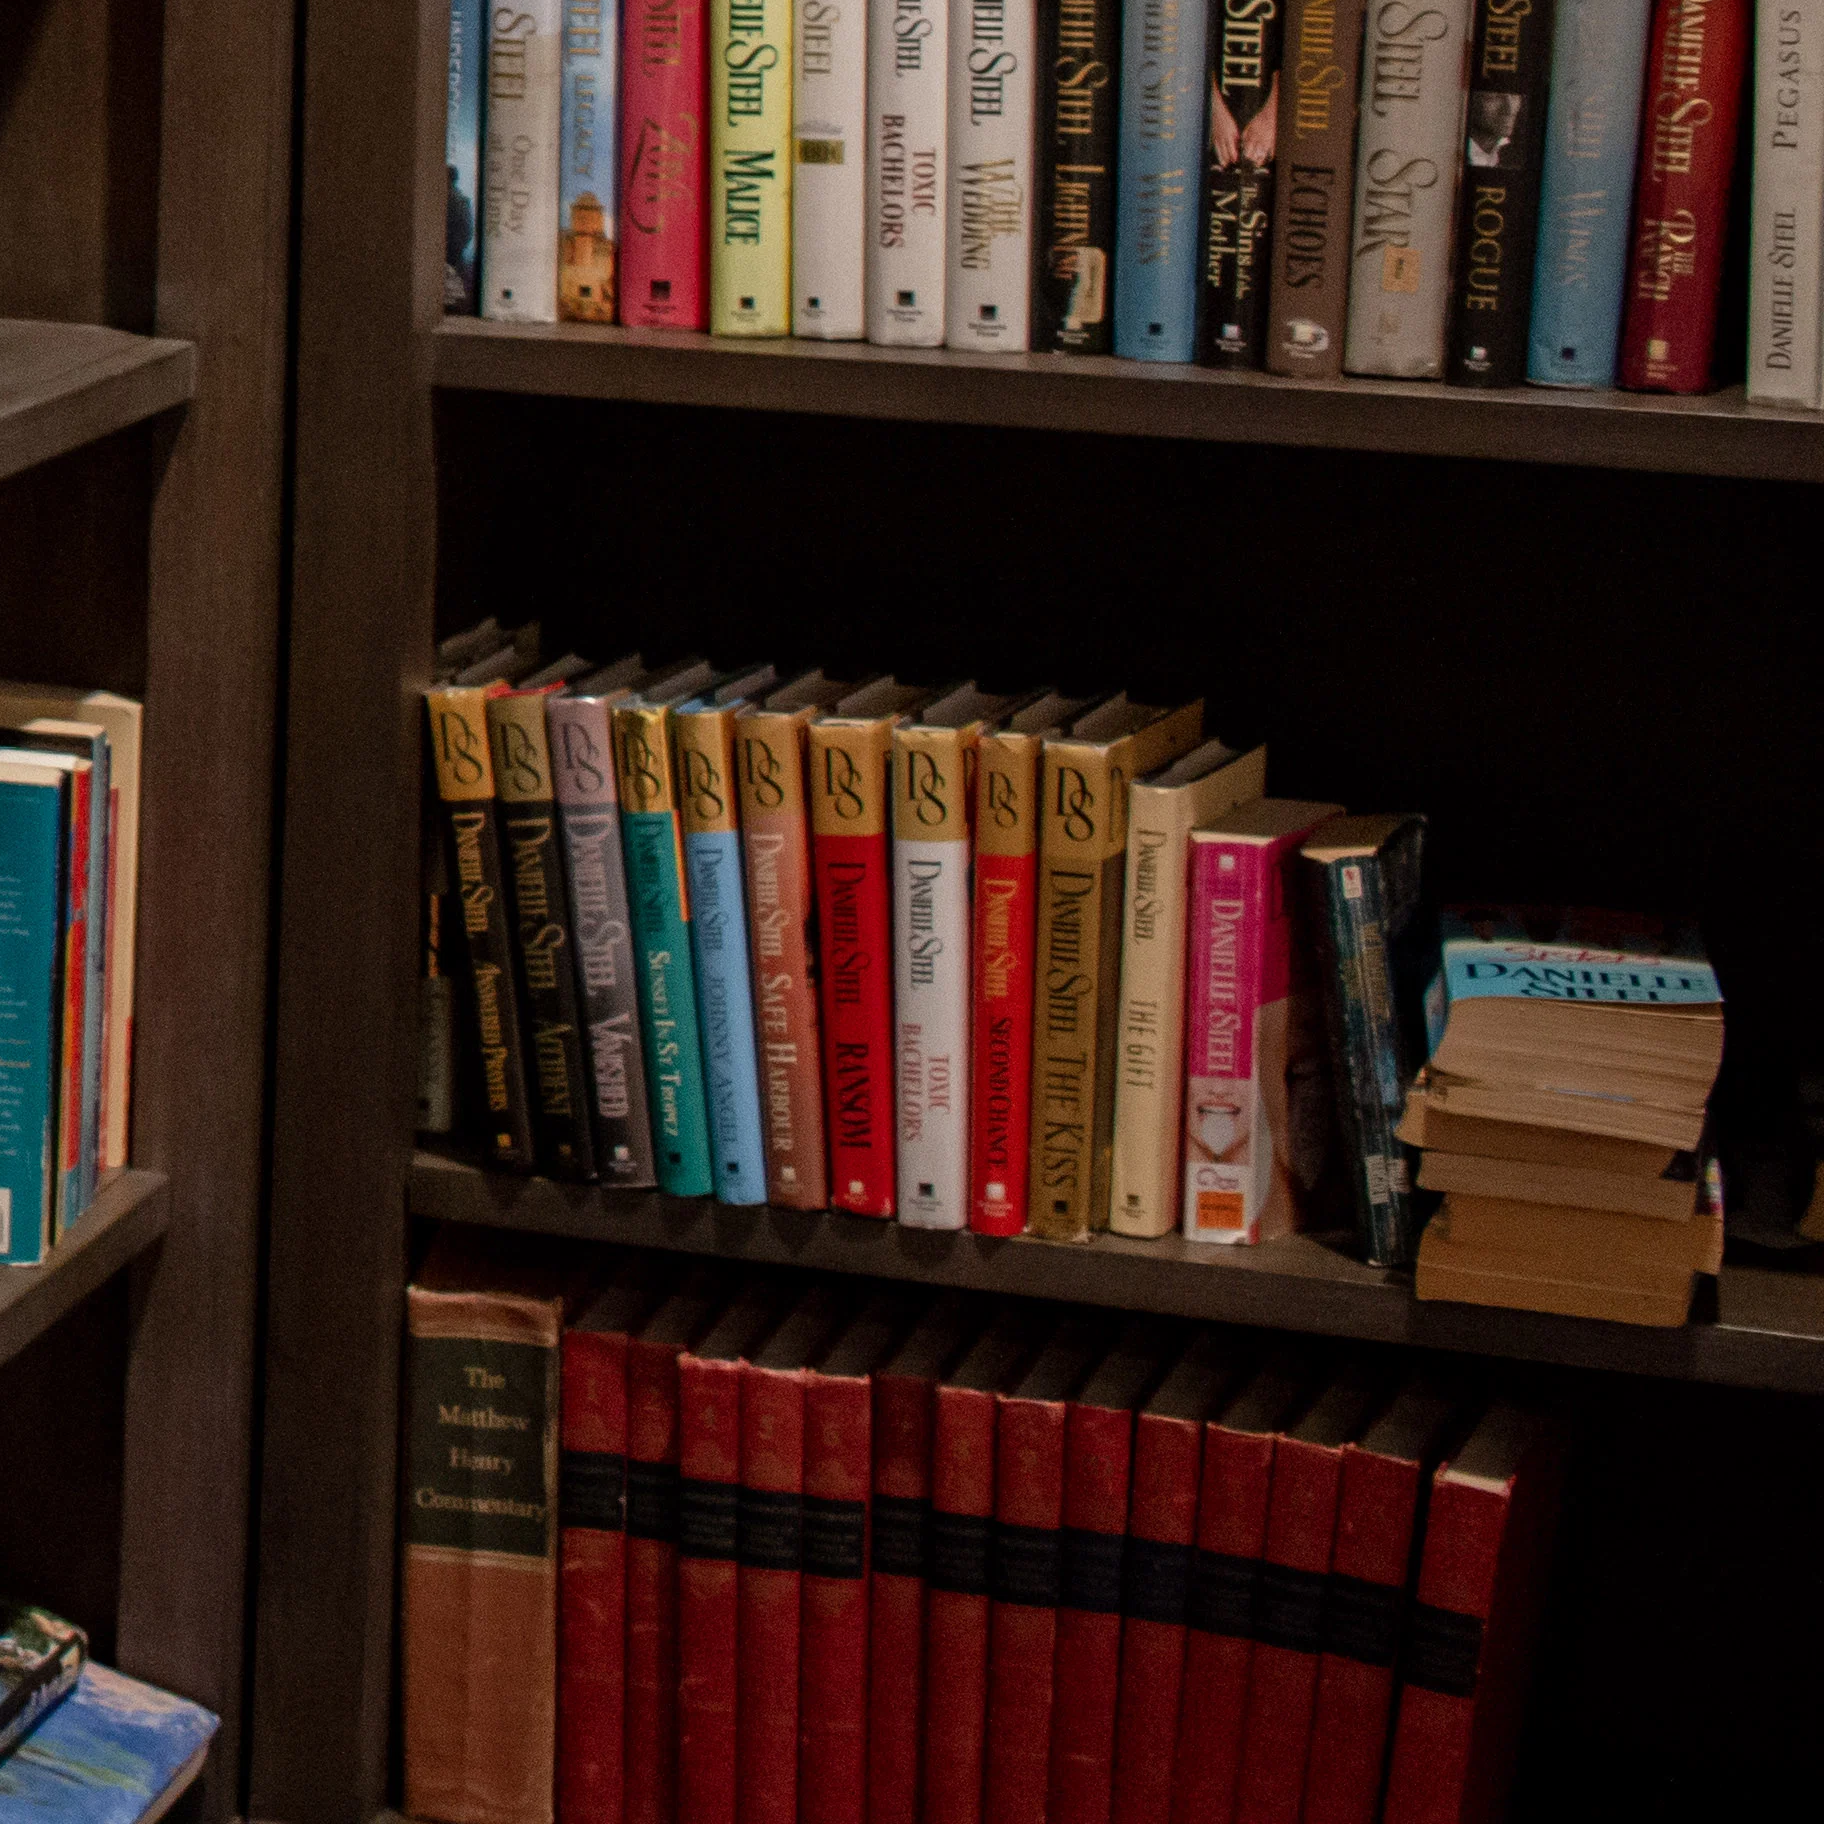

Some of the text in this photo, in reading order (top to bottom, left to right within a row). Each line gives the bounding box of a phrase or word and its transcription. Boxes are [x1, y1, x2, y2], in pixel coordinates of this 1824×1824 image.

[726, 41, 776, 127] STEEL
[1296, 64, 1345, 138] STEEL
[1372, 4, 1447, 117] STEEL
[724, 150, 774, 246] MALICE
[880, 114, 936, 248] TOXIC BACHELORS
[1286, 163, 1334, 289] ECHOES
[1358, 149, 1439, 257] STAR
[1465, 186, 1505, 310] ROGUE
[751, 834, 799, 1151] DANIELLE STEEL SAFE HARBOUR
[1125, 829, 1166, 1089] DANIELLE STEEL THE GIFT
[1467, 962, 1704, 991] DANIELLE
[1522, 981, 1659, 1001] STEEL
[1042, 870, 1094, 1187] DANIELLE STEEL THE KISS
[437, 1405, 530, 1432] Matthew
[465, 1366, 506, 1390] The
[415, 1488, 546, 1521] Commentary
[451, 1447, 513, 1476] Henry
